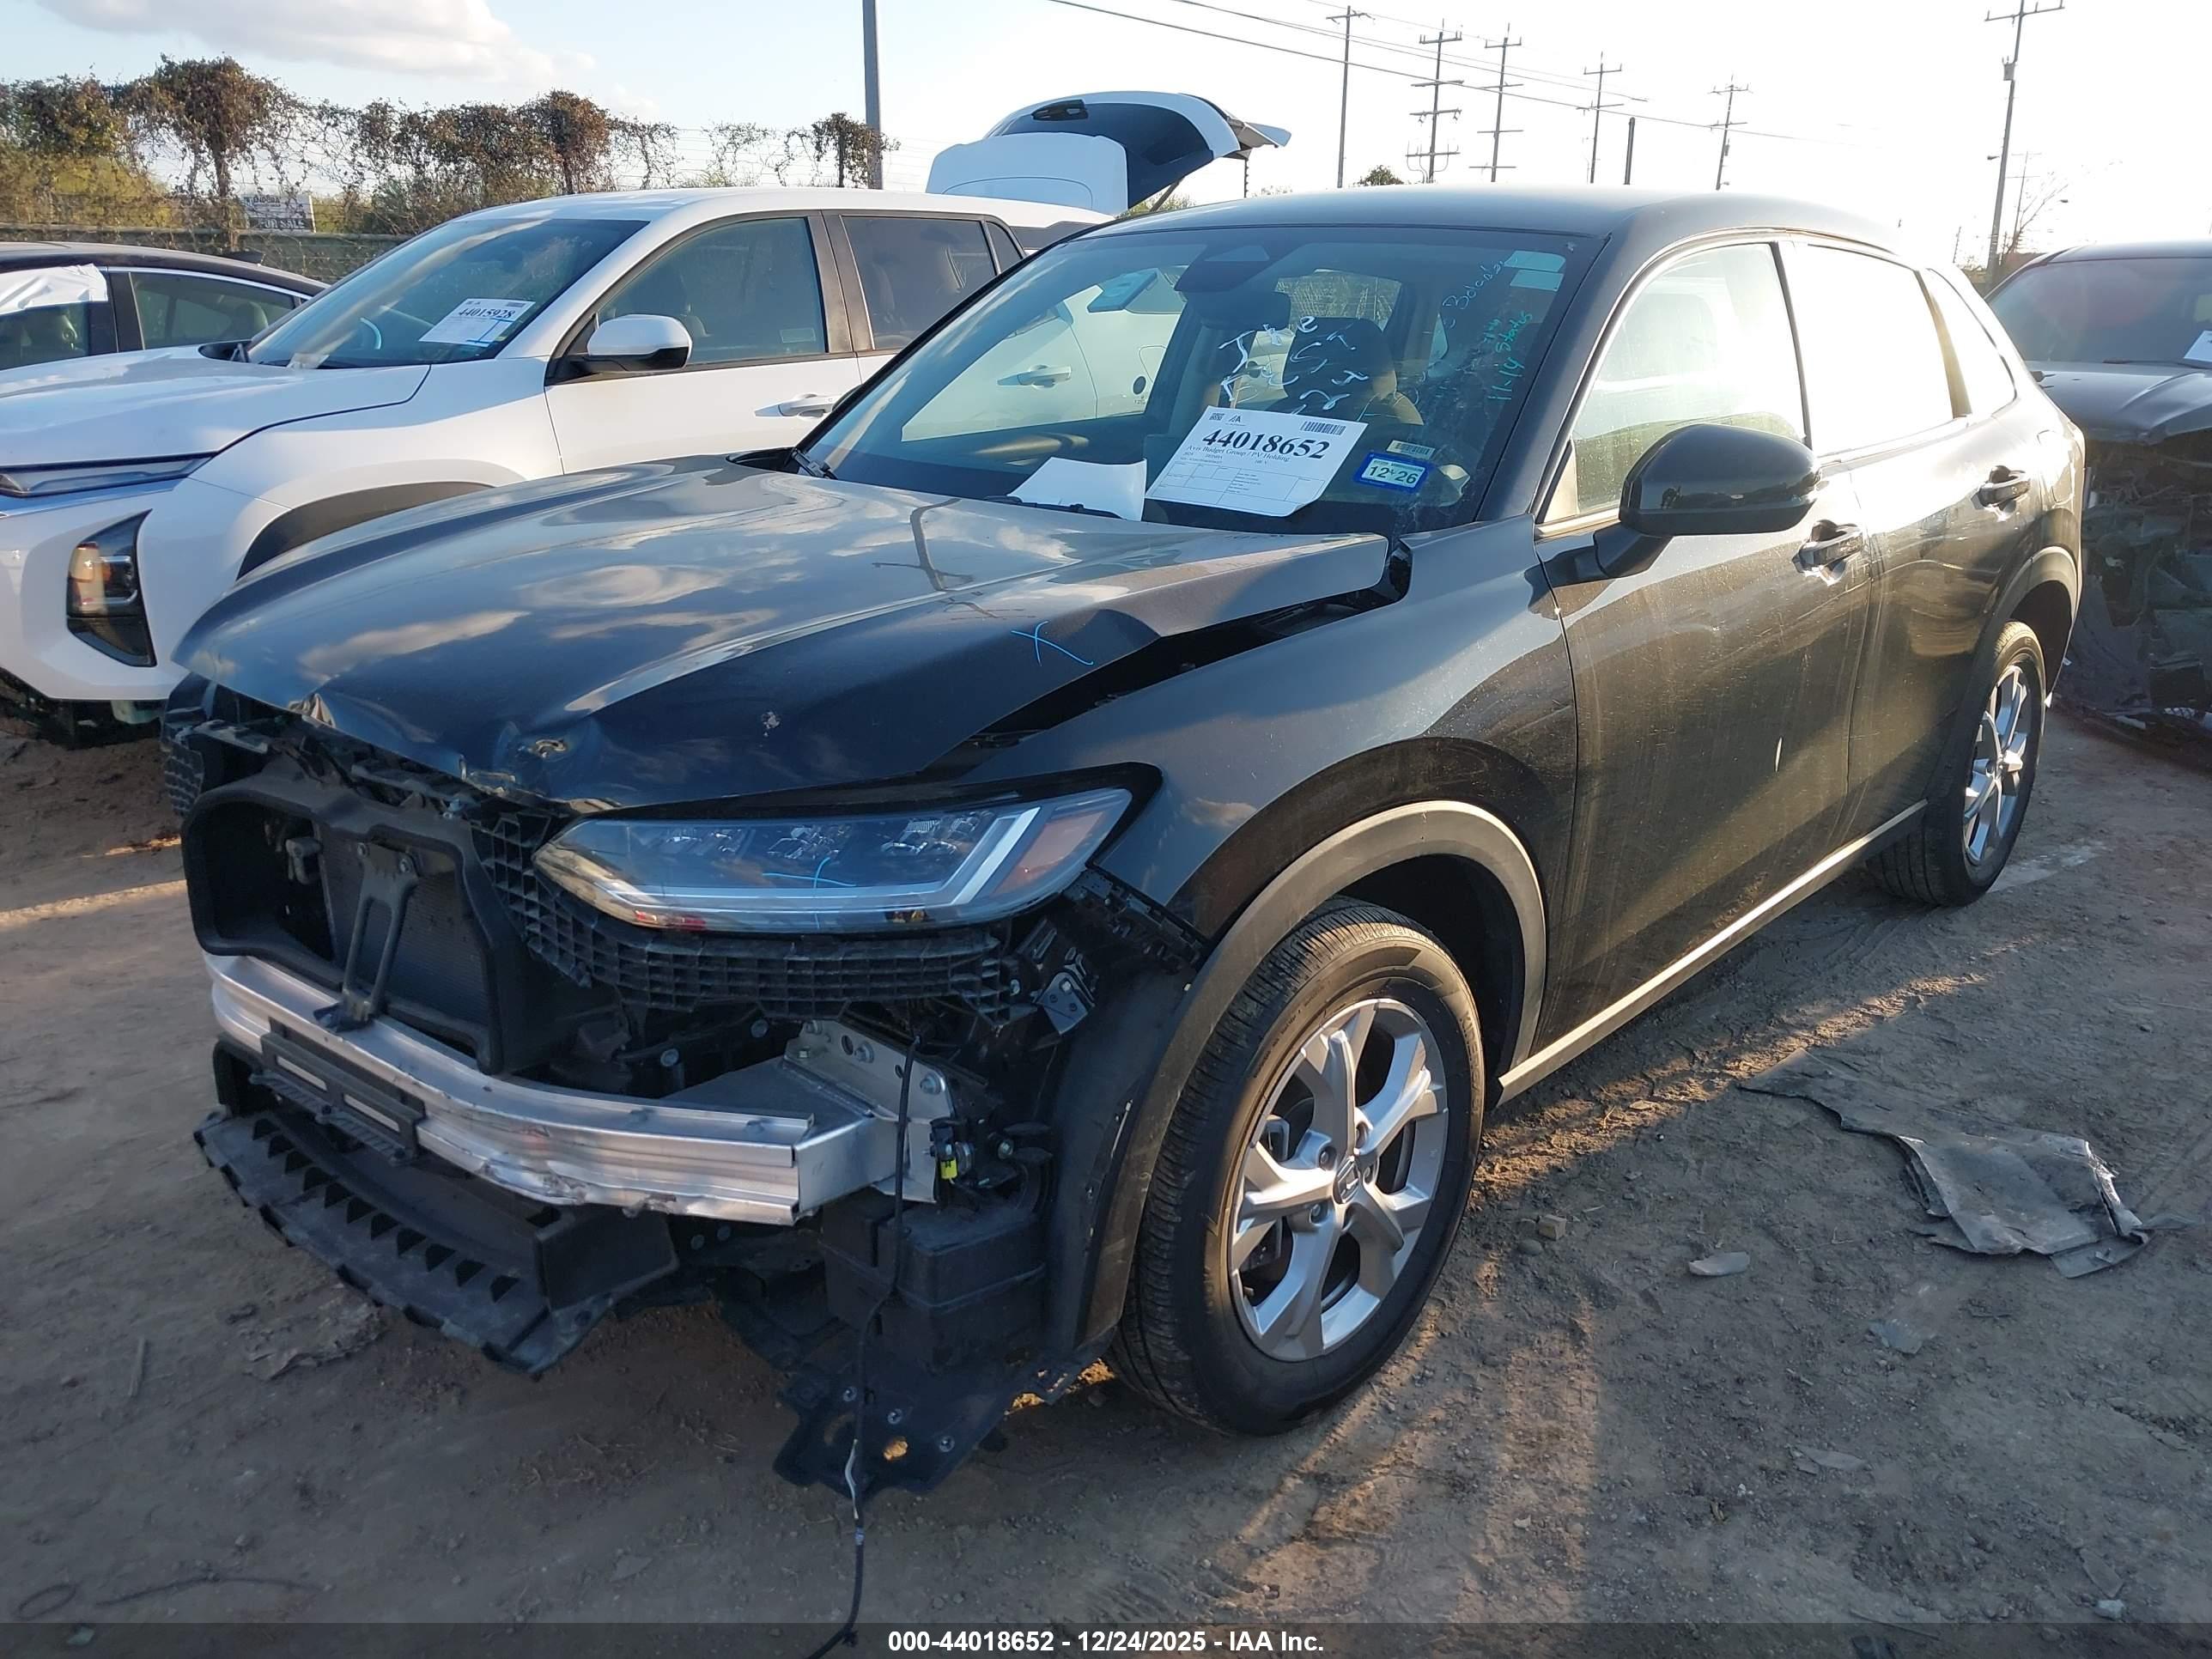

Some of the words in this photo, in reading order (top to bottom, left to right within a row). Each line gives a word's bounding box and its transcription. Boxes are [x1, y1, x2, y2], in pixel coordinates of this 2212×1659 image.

[280, 218, 305, 228] SALE
[459, 308, 516, 319] 44015928
[1202, 428, 1331, 460] 44018652
[1202, 446, 1225, 454] Budget
[1225, 448, 1247, 457] Group
[1263, 453, 1291, 463] Holding
[1370, 465, 1391, 478] 12
[1394, 471, 1419, 484] 26
